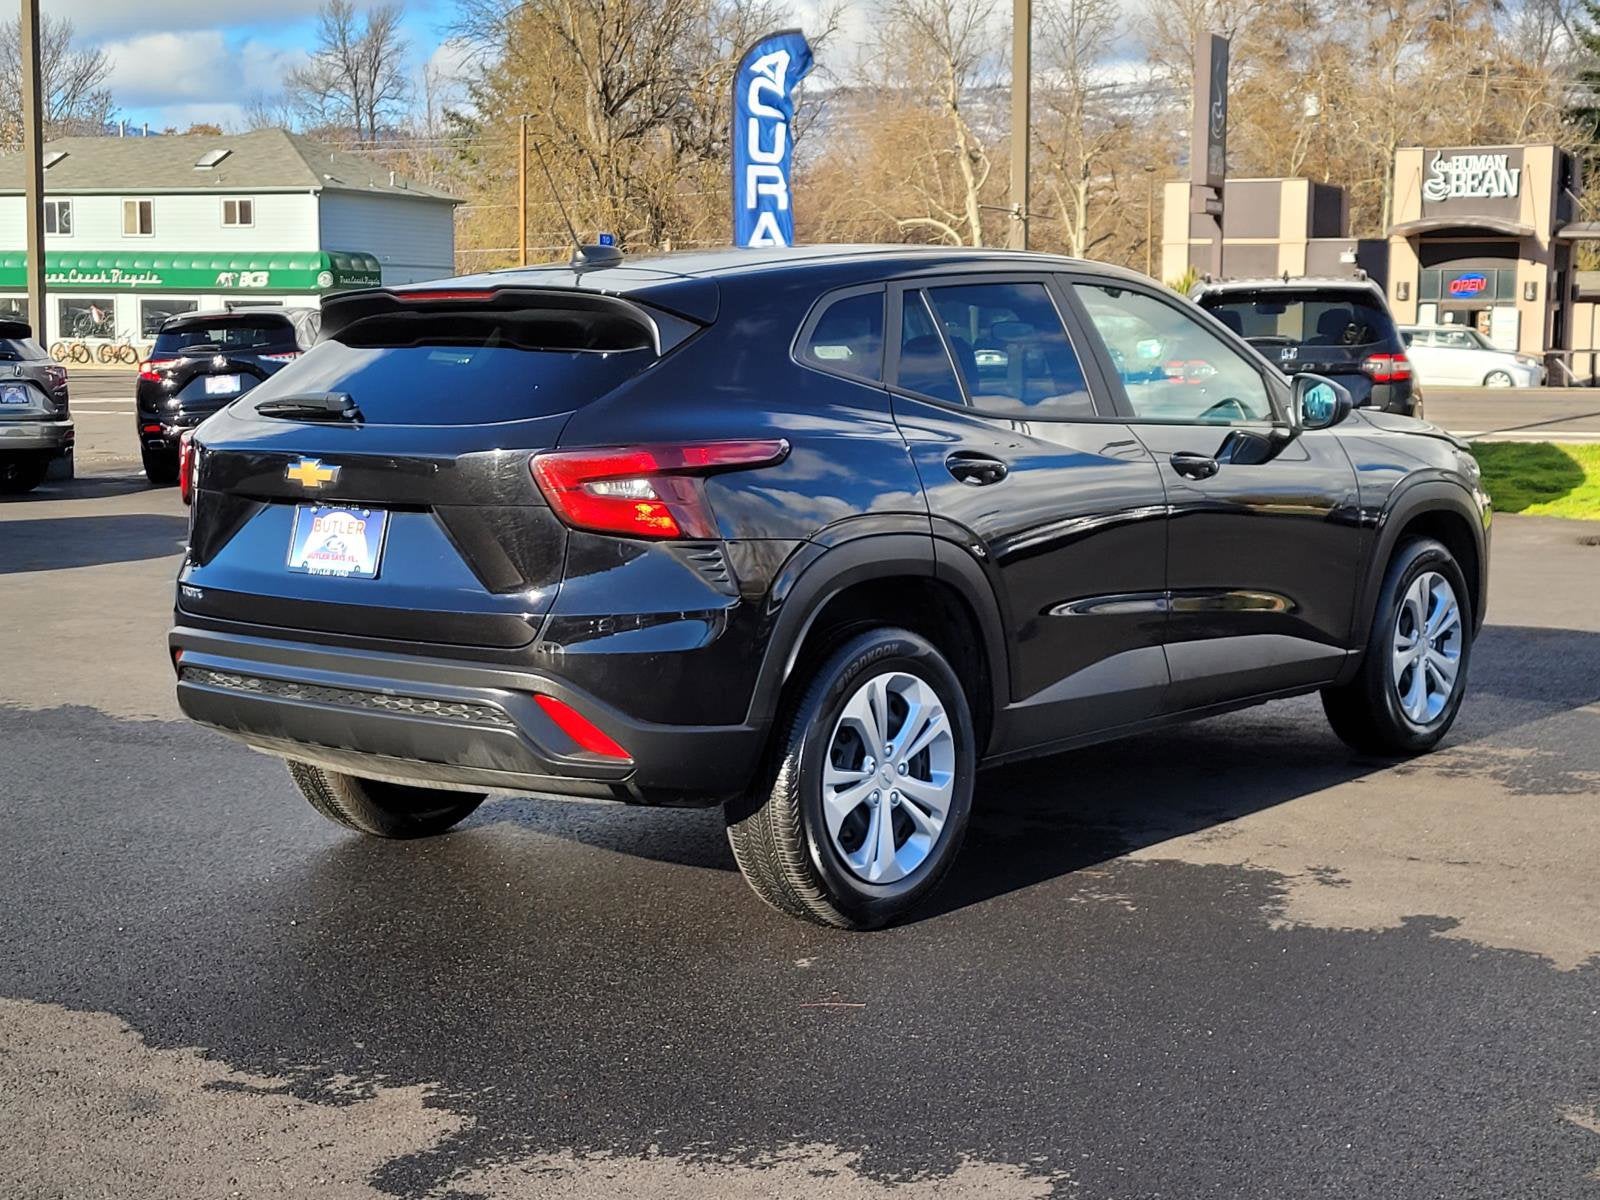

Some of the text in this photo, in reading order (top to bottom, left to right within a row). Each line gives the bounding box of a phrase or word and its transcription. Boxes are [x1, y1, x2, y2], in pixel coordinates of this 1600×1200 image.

[746, 49, 790, 248] ACURA
[1451, 154, 1508, 172] HUMAN
[1448, 168, 1520, 197] BEAN
[45, 271, 69, 283] ear
[110, 268, 163, 287] Bicycle
[1449, 278, 1487, 292] OPEN
[1283, 362, 1334, 372] LOT
[314, 519, 365, 535] BUTLER
